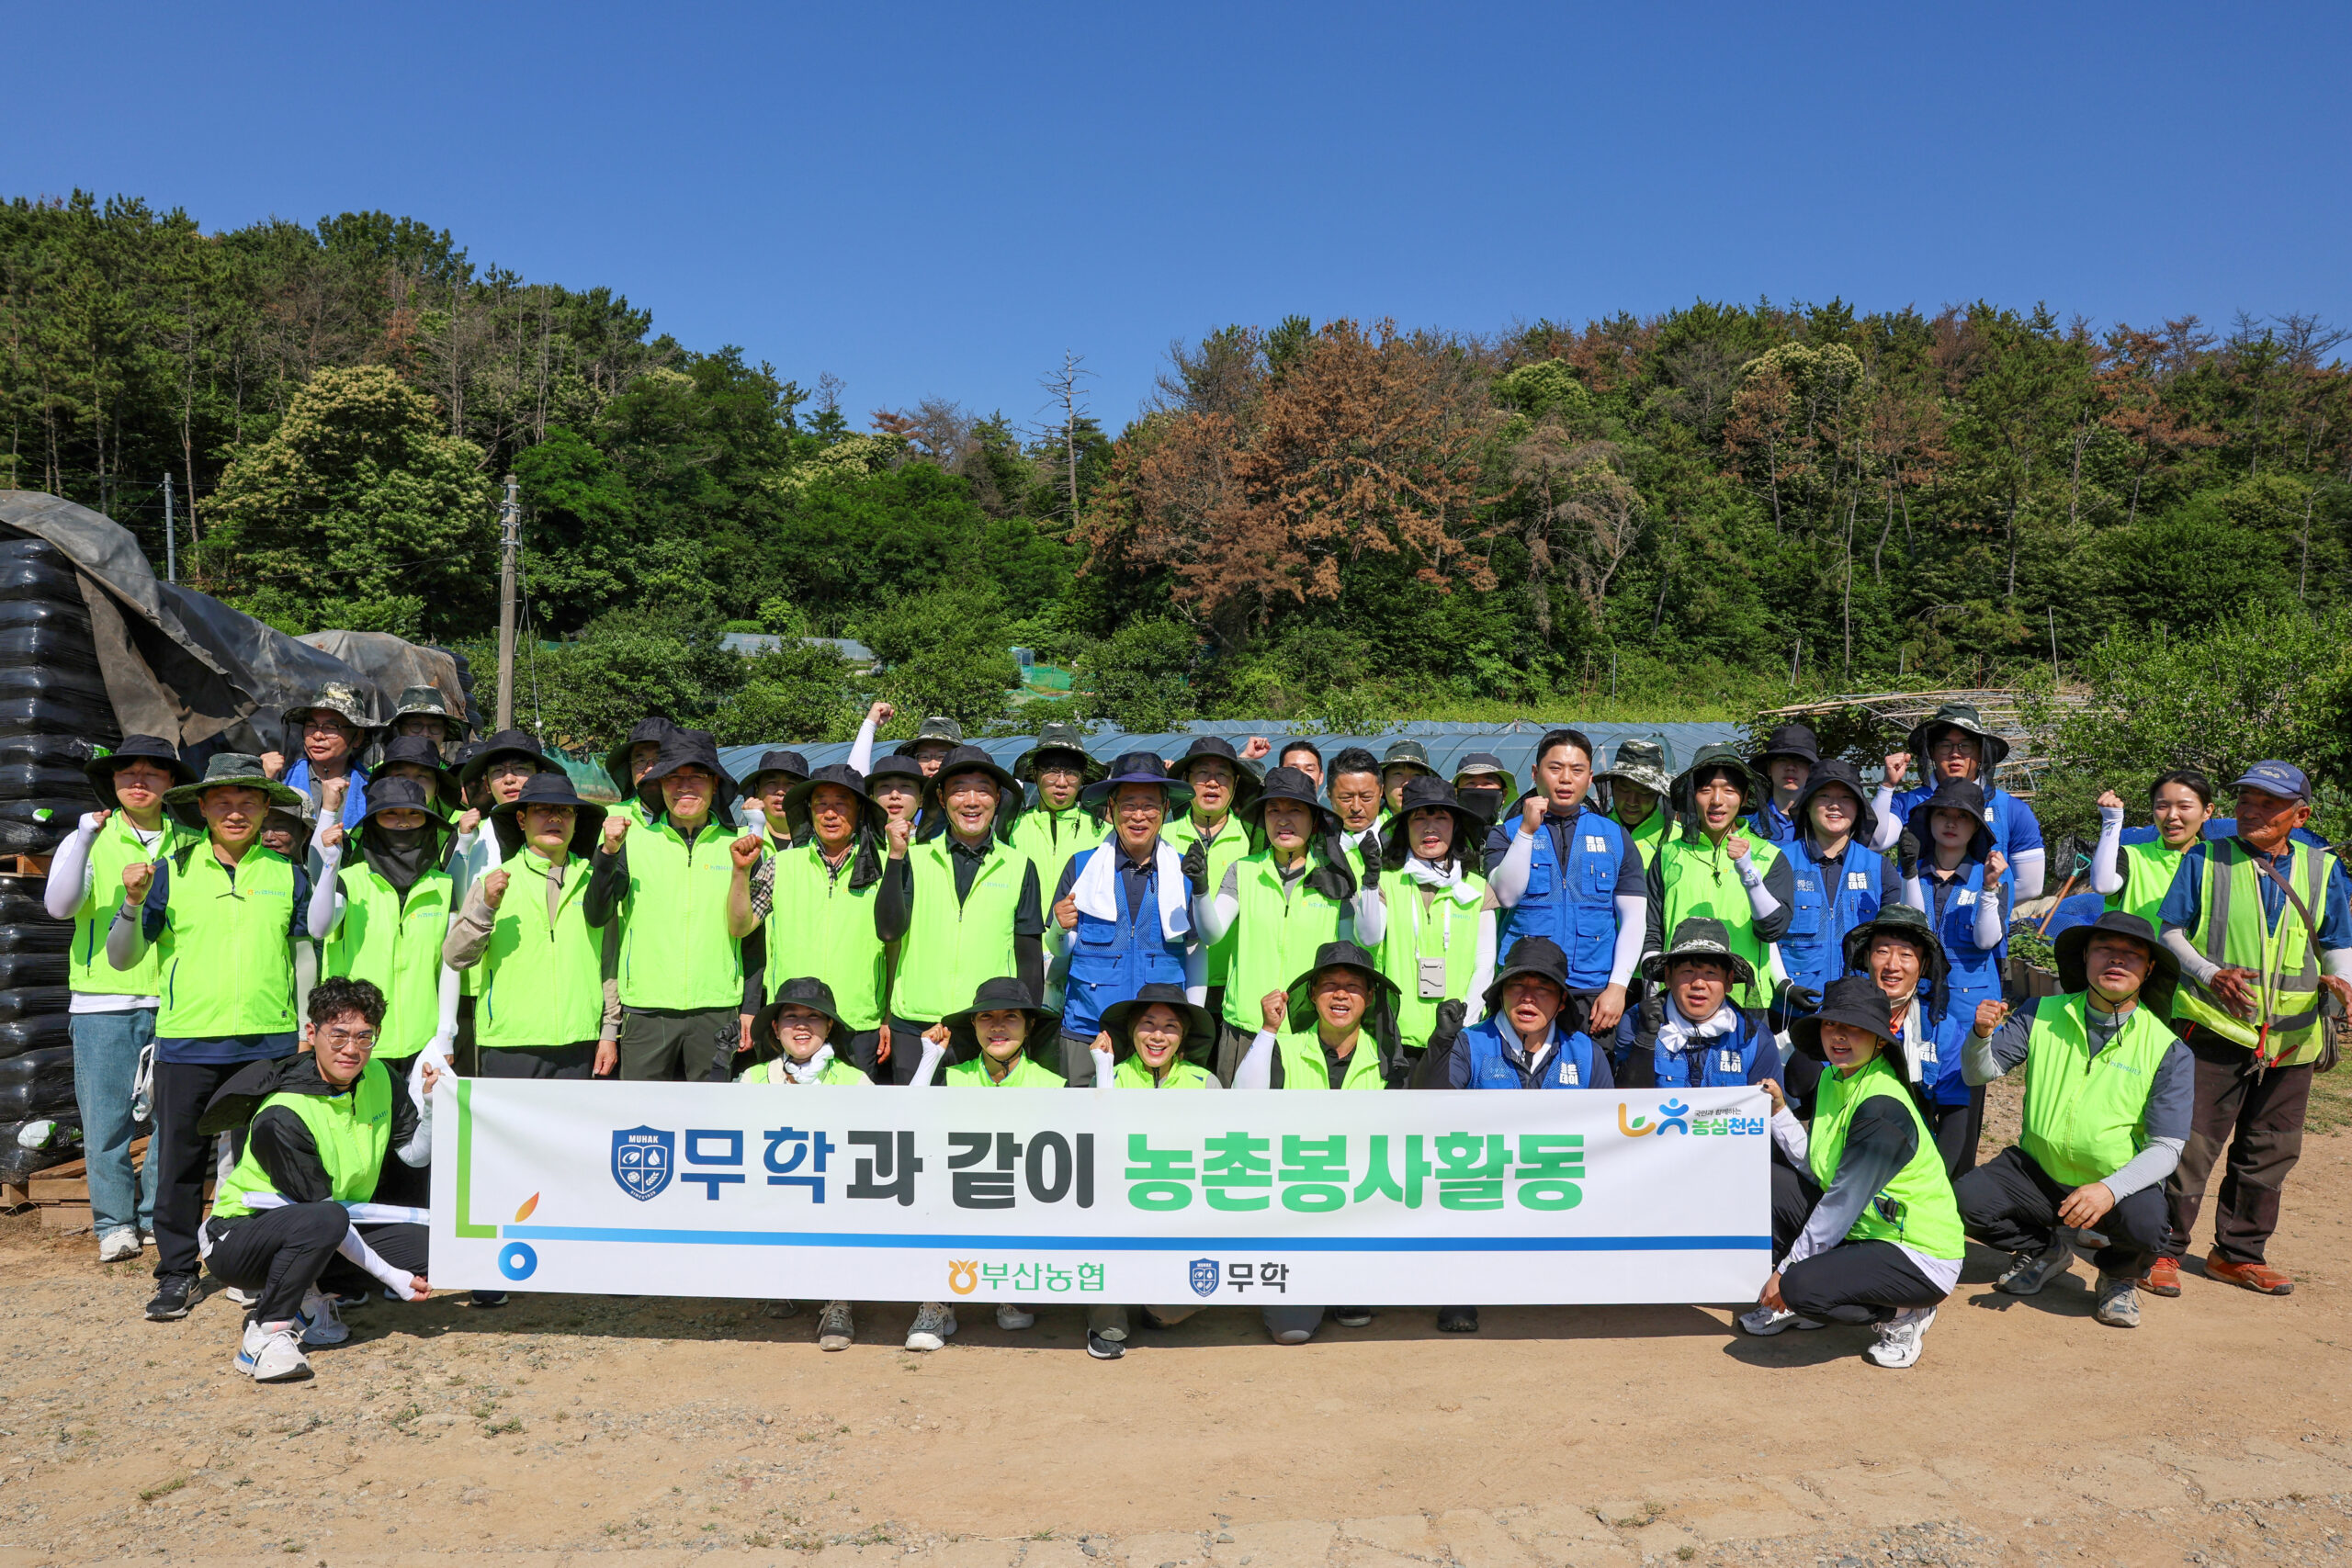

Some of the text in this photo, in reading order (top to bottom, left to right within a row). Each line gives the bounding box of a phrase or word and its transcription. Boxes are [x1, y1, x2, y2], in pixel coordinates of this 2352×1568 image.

[1694, 1109, 1713, 1117] 국민과
[1691, 1117, 1765, 1136] 농심천심
[628, 1134, 659, 1144] MUHAK
[680, 1126, 1587, 1213] 무학과 같이 농촌봉사활동
[980, 1262, 1104, 1292] 부산농협
[1227, 1261, 1290, 1293] 무학
